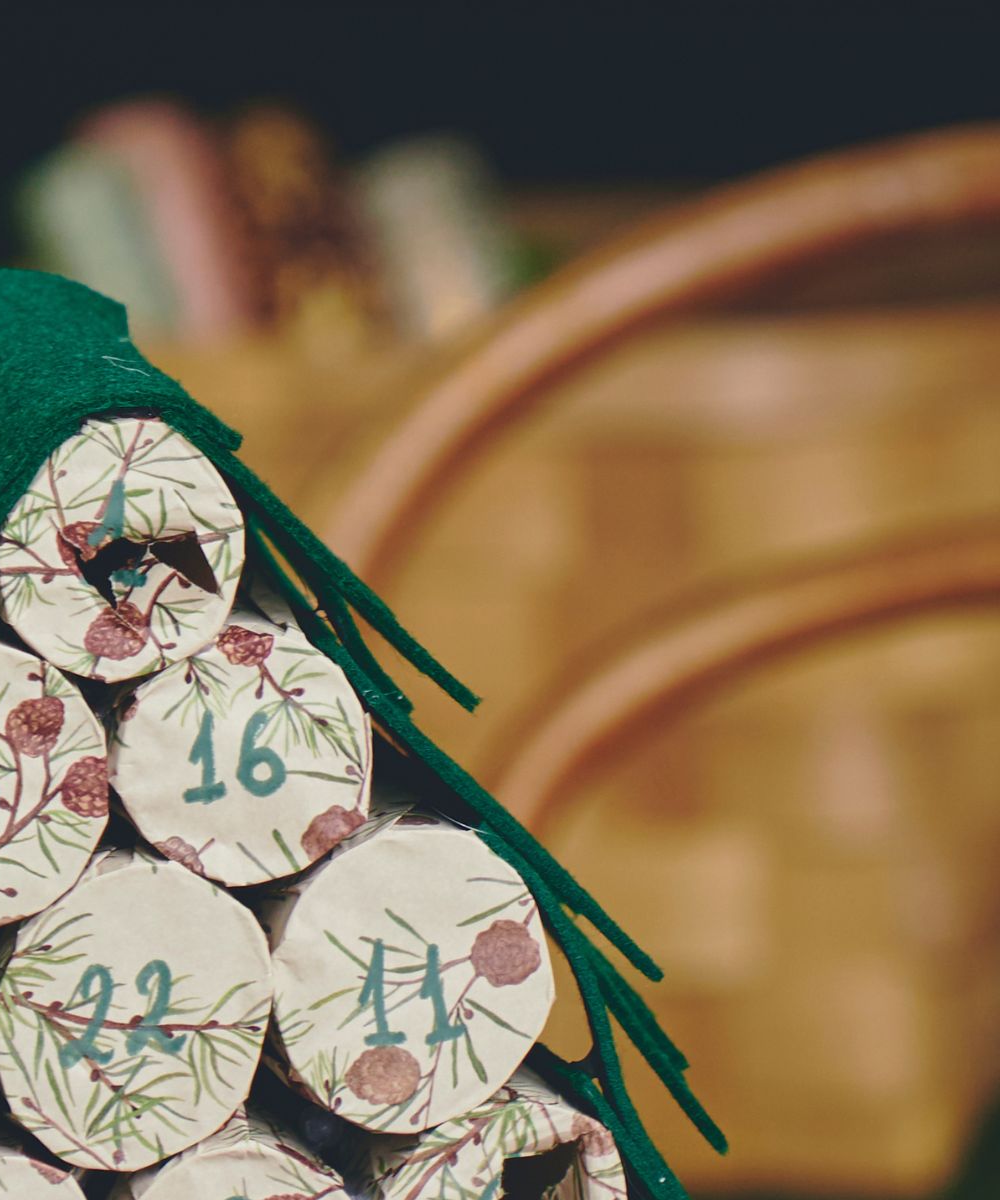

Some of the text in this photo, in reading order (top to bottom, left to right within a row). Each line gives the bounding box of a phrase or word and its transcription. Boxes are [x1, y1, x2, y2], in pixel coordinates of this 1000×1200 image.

[183, 711, 287, 804] 16
[59, 959, 184, 1067] 22
[359, 939, 463, 1045] 11
